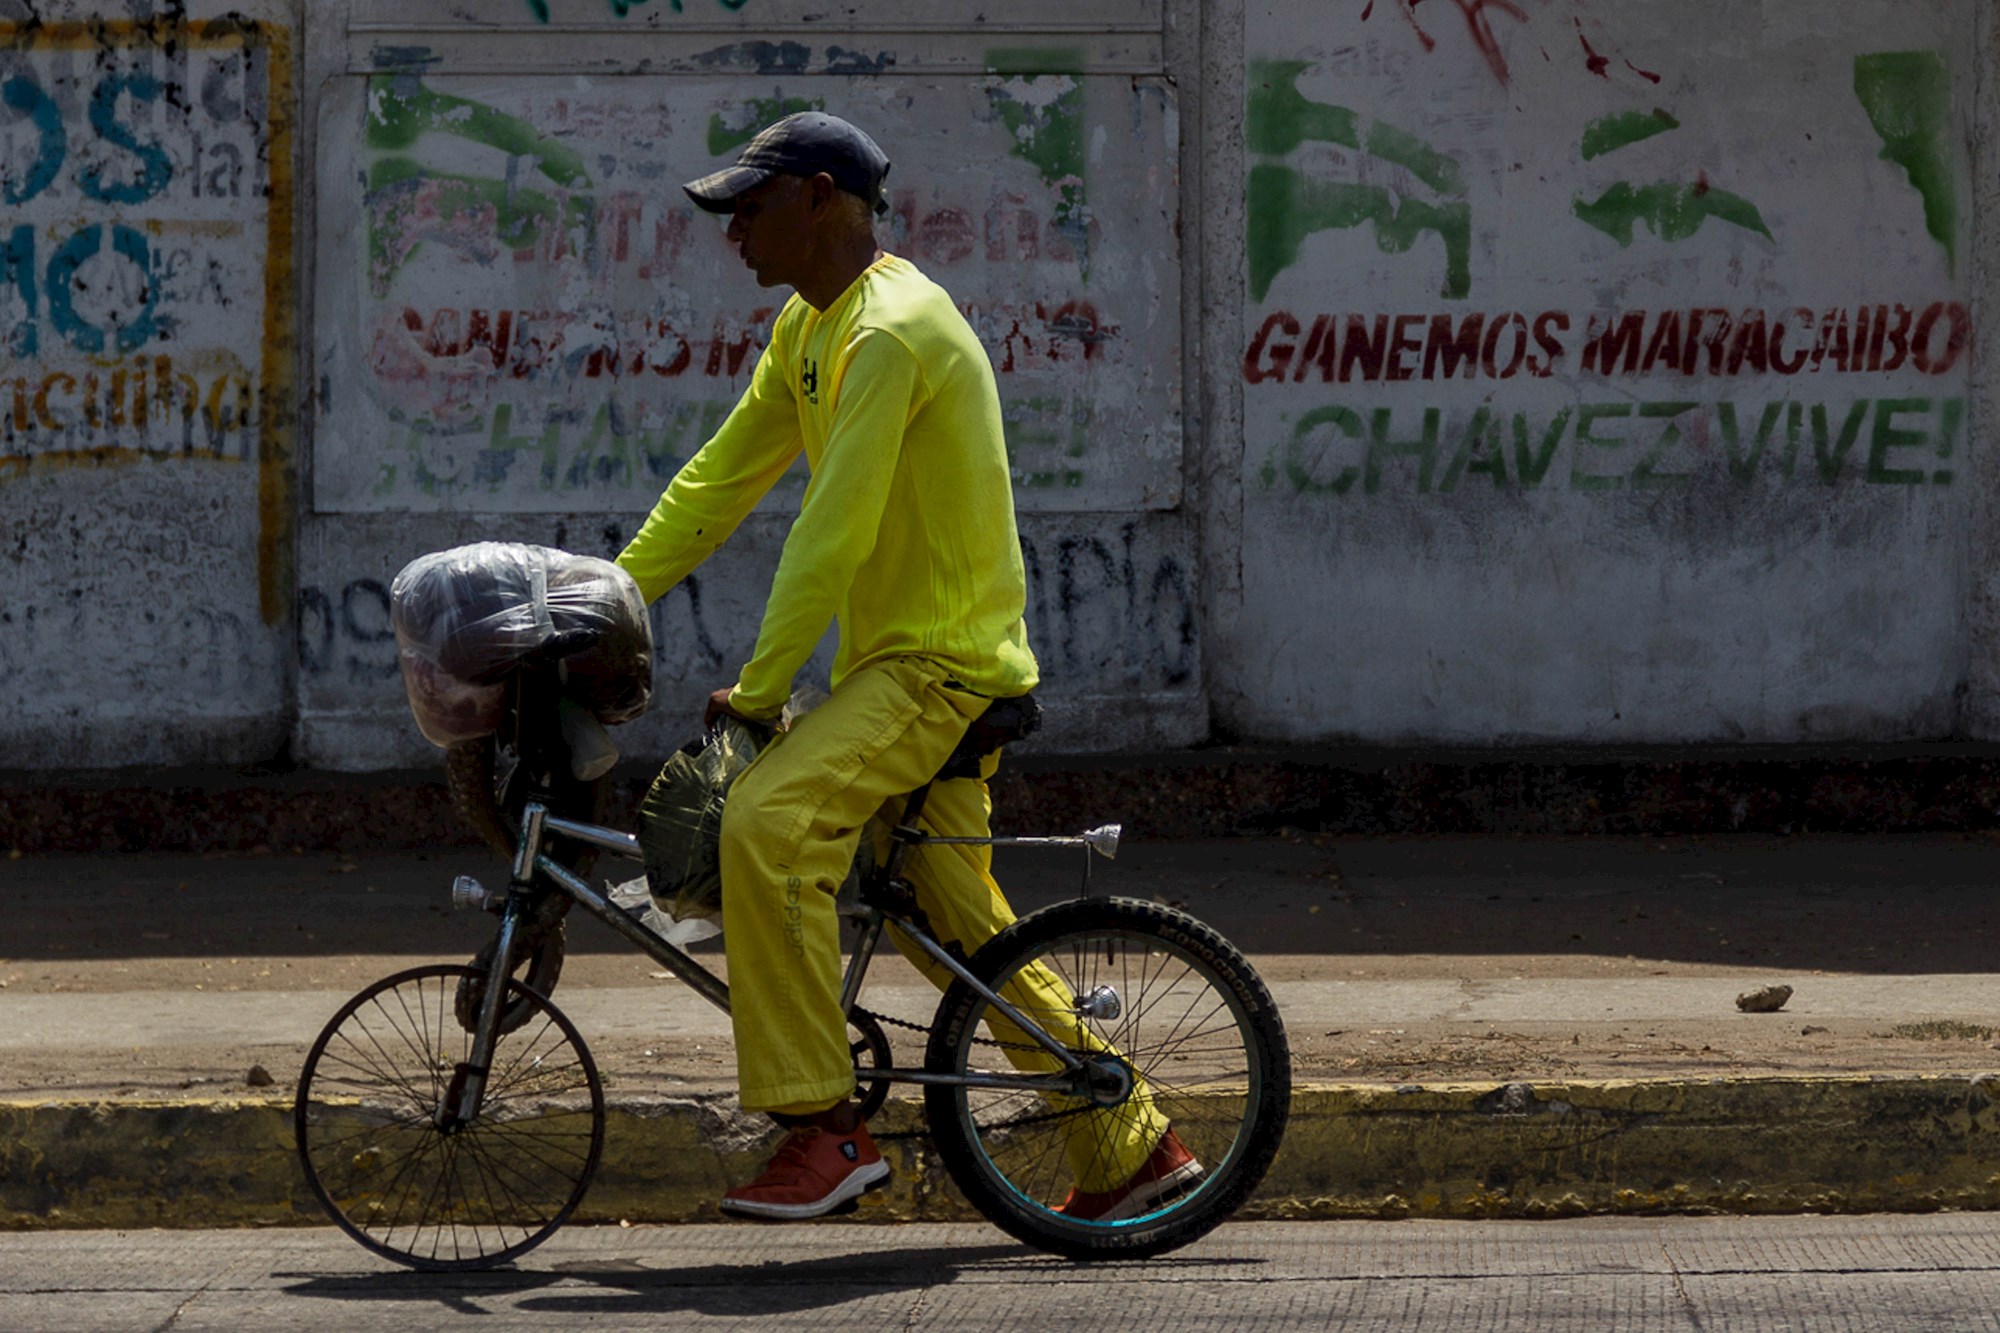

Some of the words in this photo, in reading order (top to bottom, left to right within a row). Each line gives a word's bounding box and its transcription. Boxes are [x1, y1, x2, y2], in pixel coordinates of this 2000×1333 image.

[1243, 310, 1571, 385] GANEMOS
[1580, 301, 1969, 379] MARACAIBO
[1717, 397, 1966, 488] VIVE!
[783, 875, 804, 958] adidas
[1158, 924, 1260, 1013] MOTOCROSS
